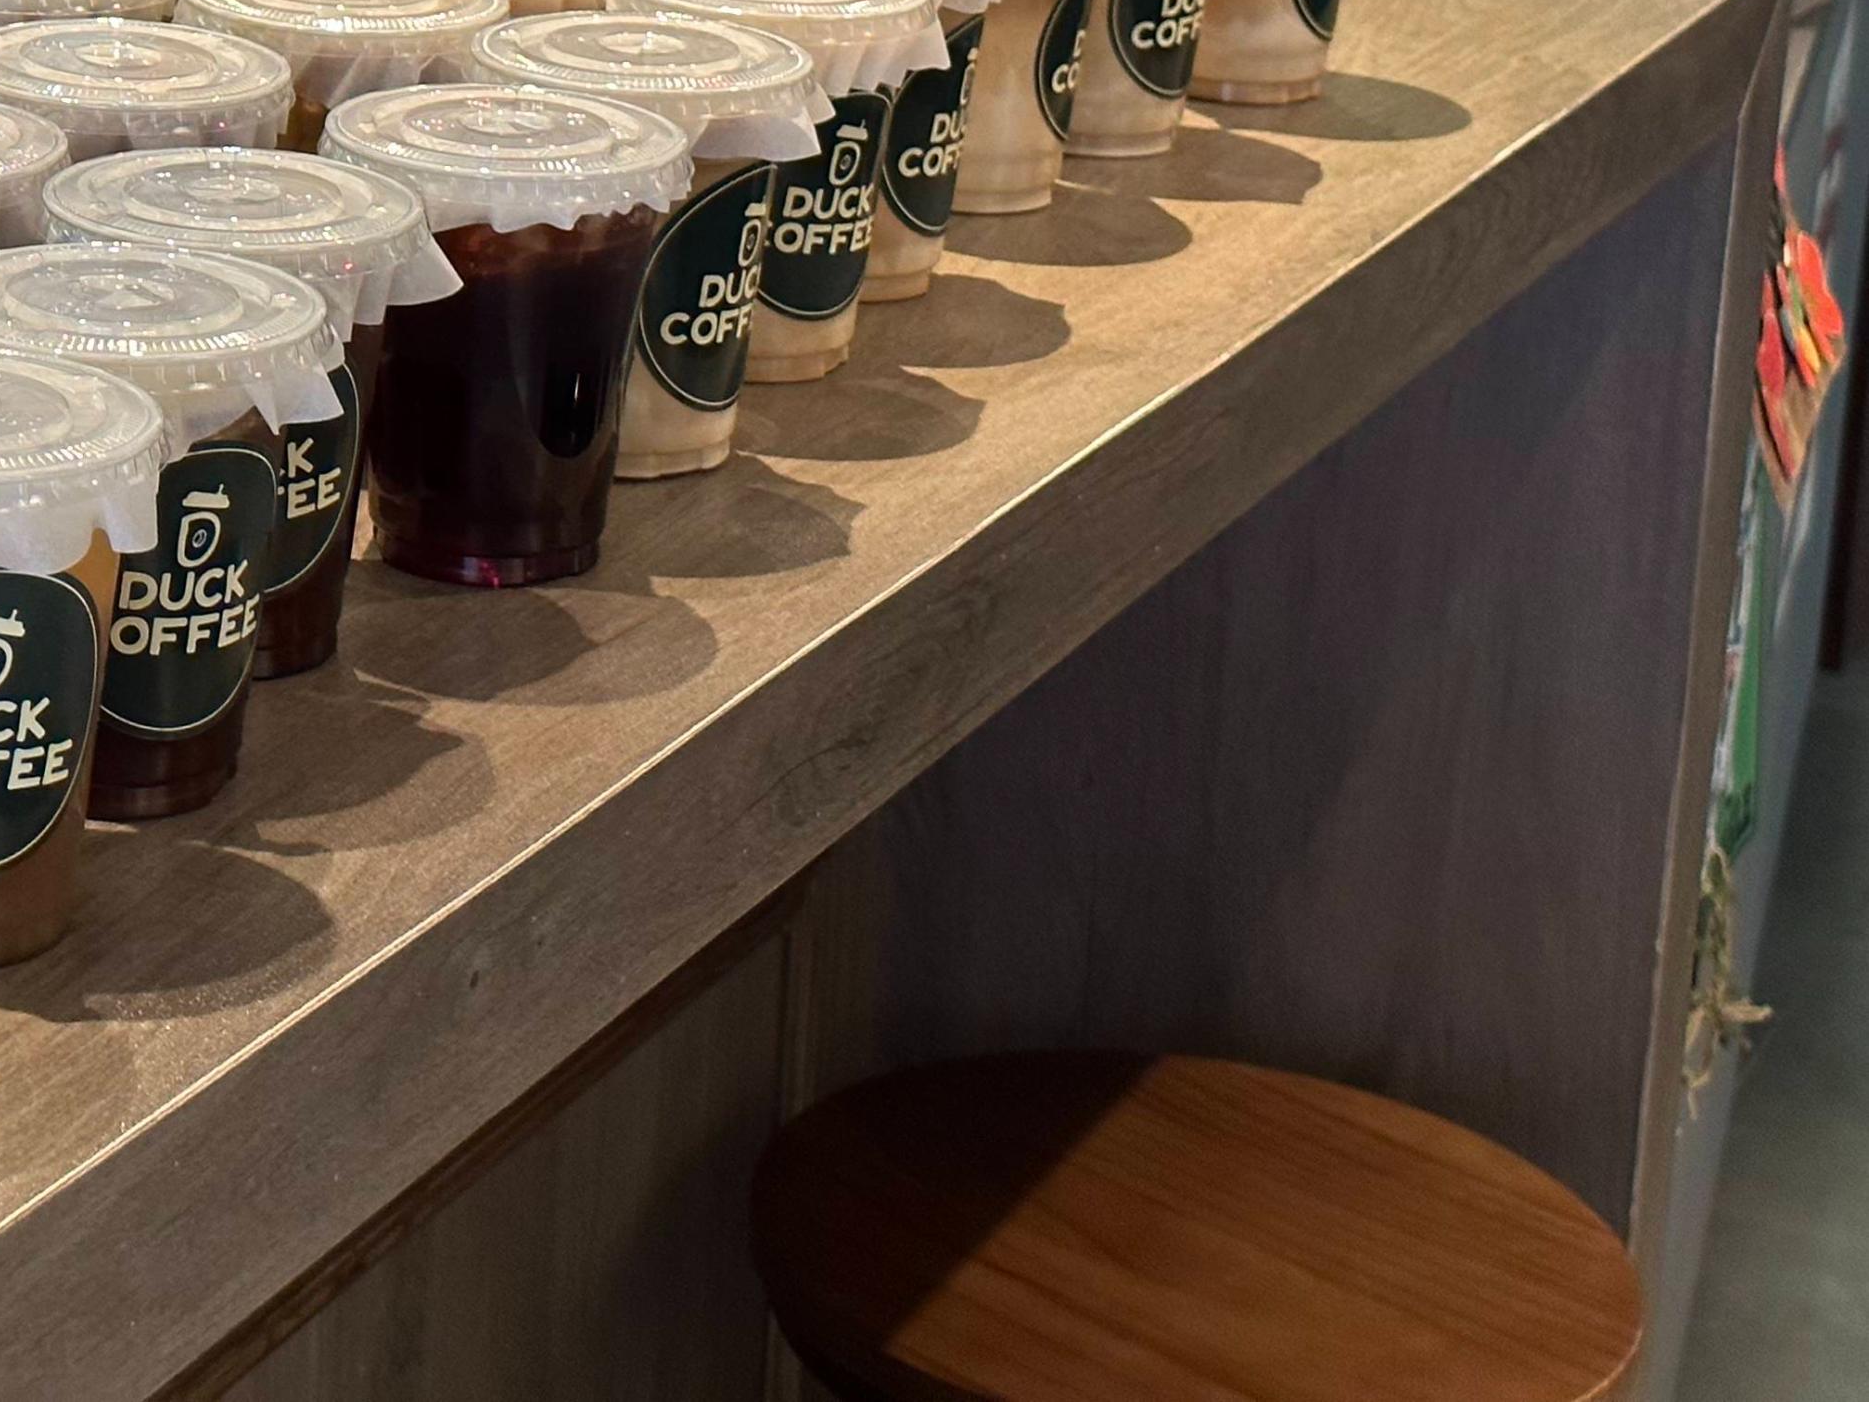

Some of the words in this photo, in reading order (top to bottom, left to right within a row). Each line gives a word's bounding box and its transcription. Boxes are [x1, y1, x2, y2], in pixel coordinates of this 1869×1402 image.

[1131, 11, 1204, 49] COFF
[783, 183, 874, 219] DUCK
[699, 263, 761, 308] DUC
[660, 303, 753, 345] COFF
[118, 559, 248, 611] DUCK
[110, 593, 261, 656] OFFEE
